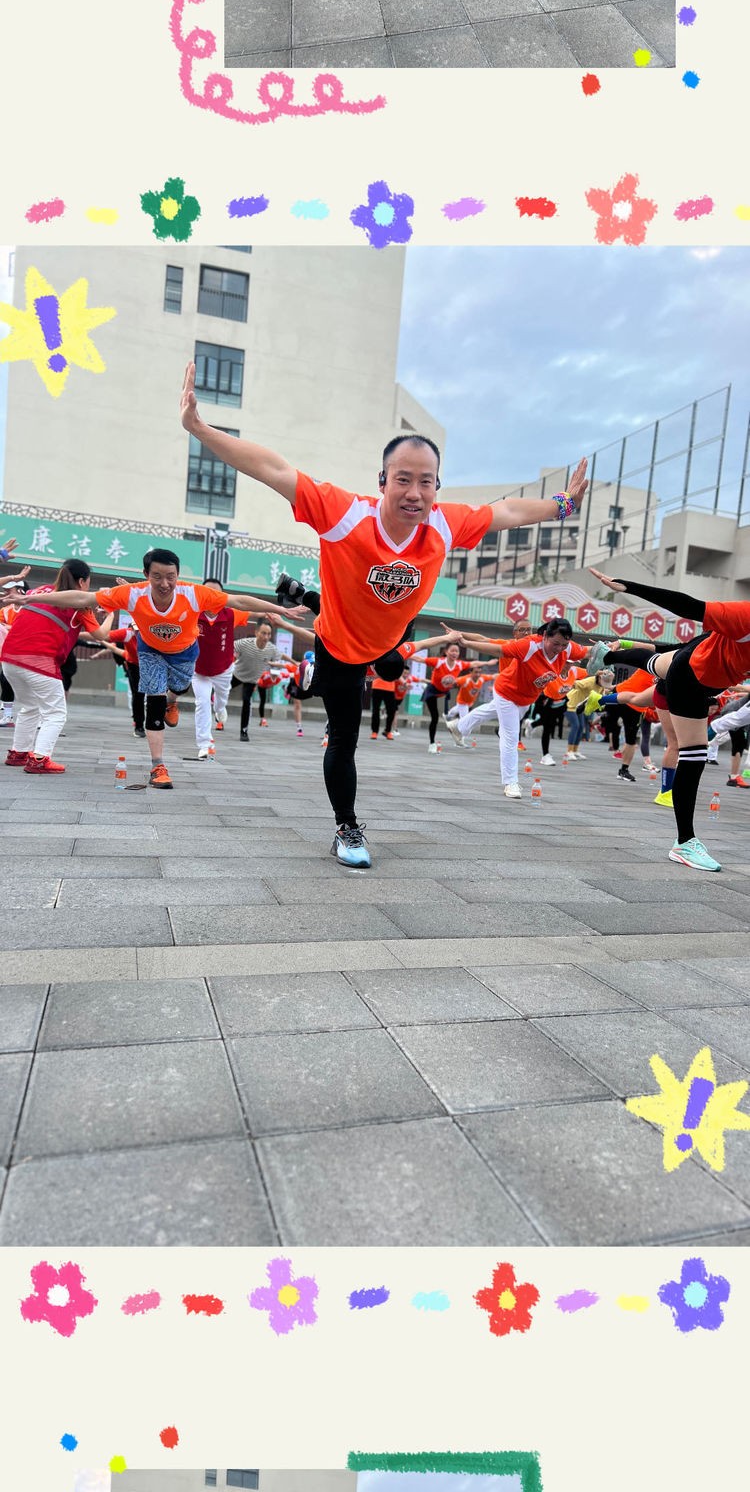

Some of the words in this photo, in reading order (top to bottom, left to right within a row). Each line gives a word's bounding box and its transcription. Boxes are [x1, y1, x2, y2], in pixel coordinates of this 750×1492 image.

[29, 525, 154, 565] 廉洁奉
[509, 599, 694, 637] 为政不移公仆
